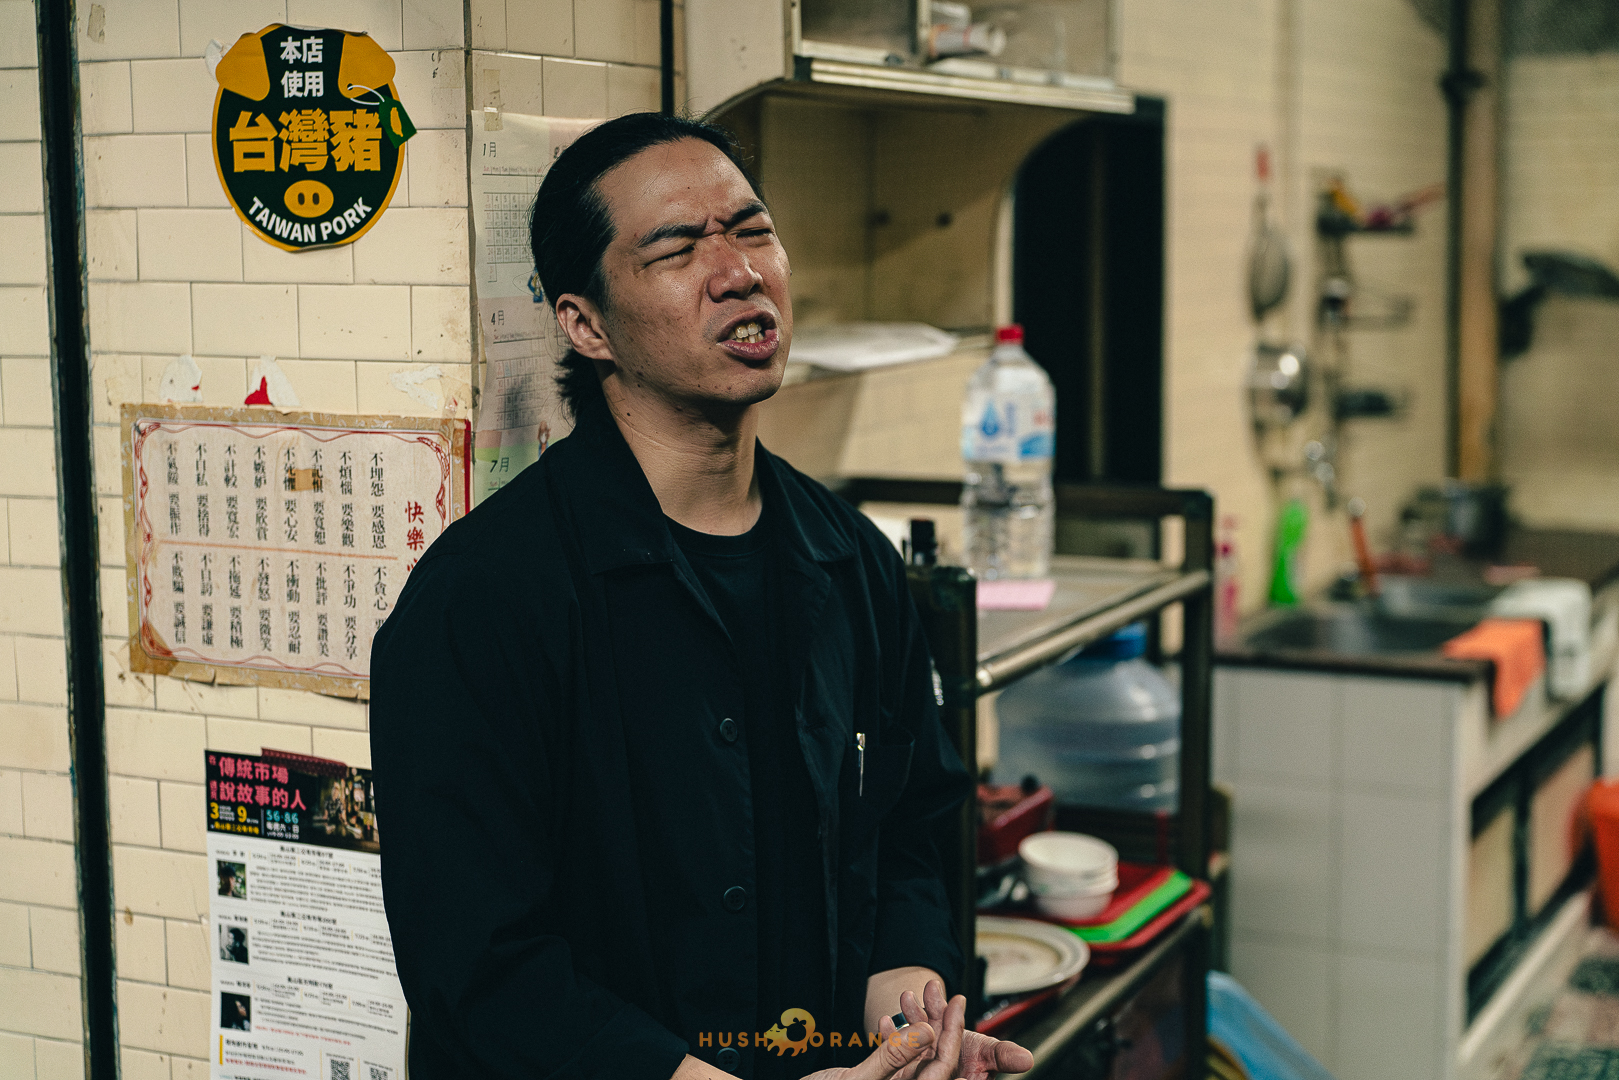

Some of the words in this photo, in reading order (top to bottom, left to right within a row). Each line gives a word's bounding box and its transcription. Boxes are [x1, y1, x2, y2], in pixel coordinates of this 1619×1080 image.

[280, 36, 323, 64] 本店
[281, 70, 324, 98] 使用
[229, 108, 382, 172] 台灣豬
[249, 196, 316, 243] TAIWAN
[320, 196, 372, 241] PORK
[491, 309, 505, 326] 4月
[195, 443, 208, 487] 不自私
[224, 444, 237, 488] 不計較
[338, 450, 353, 495] 不煩惱
[369, 452, 385, 497] 不埋怨
[490, 456, 510, 473] 7月
[255, 496, 269, 541] 要欣賞
[284, 499, 298, 543] 要心安
[313, 501, 326, 545] 要寬恕
[341, 502, 355, 548] 要樂觀
[371, 504, 387, 549] 要感恩
[228, 555, 241, 599] 不拖延
[258, 557, 271, 601] 不發怒
[315, 561, 328, 606] 不批評
[372, 566, 388, 611] 不貪心
[230, 605, 243, 649] 要積極
[259, 608, 272, 652] 要微笑
[288, 610, 301, 655] 要忍耐
[344, 615, 357, 660] 要分享
[218, 756, 289, 785] 傳統市場
[210, 801, 220, 820] 3
[219, 780, 307, 811] 說故事的人
[237, 805, 248, 823] 9
